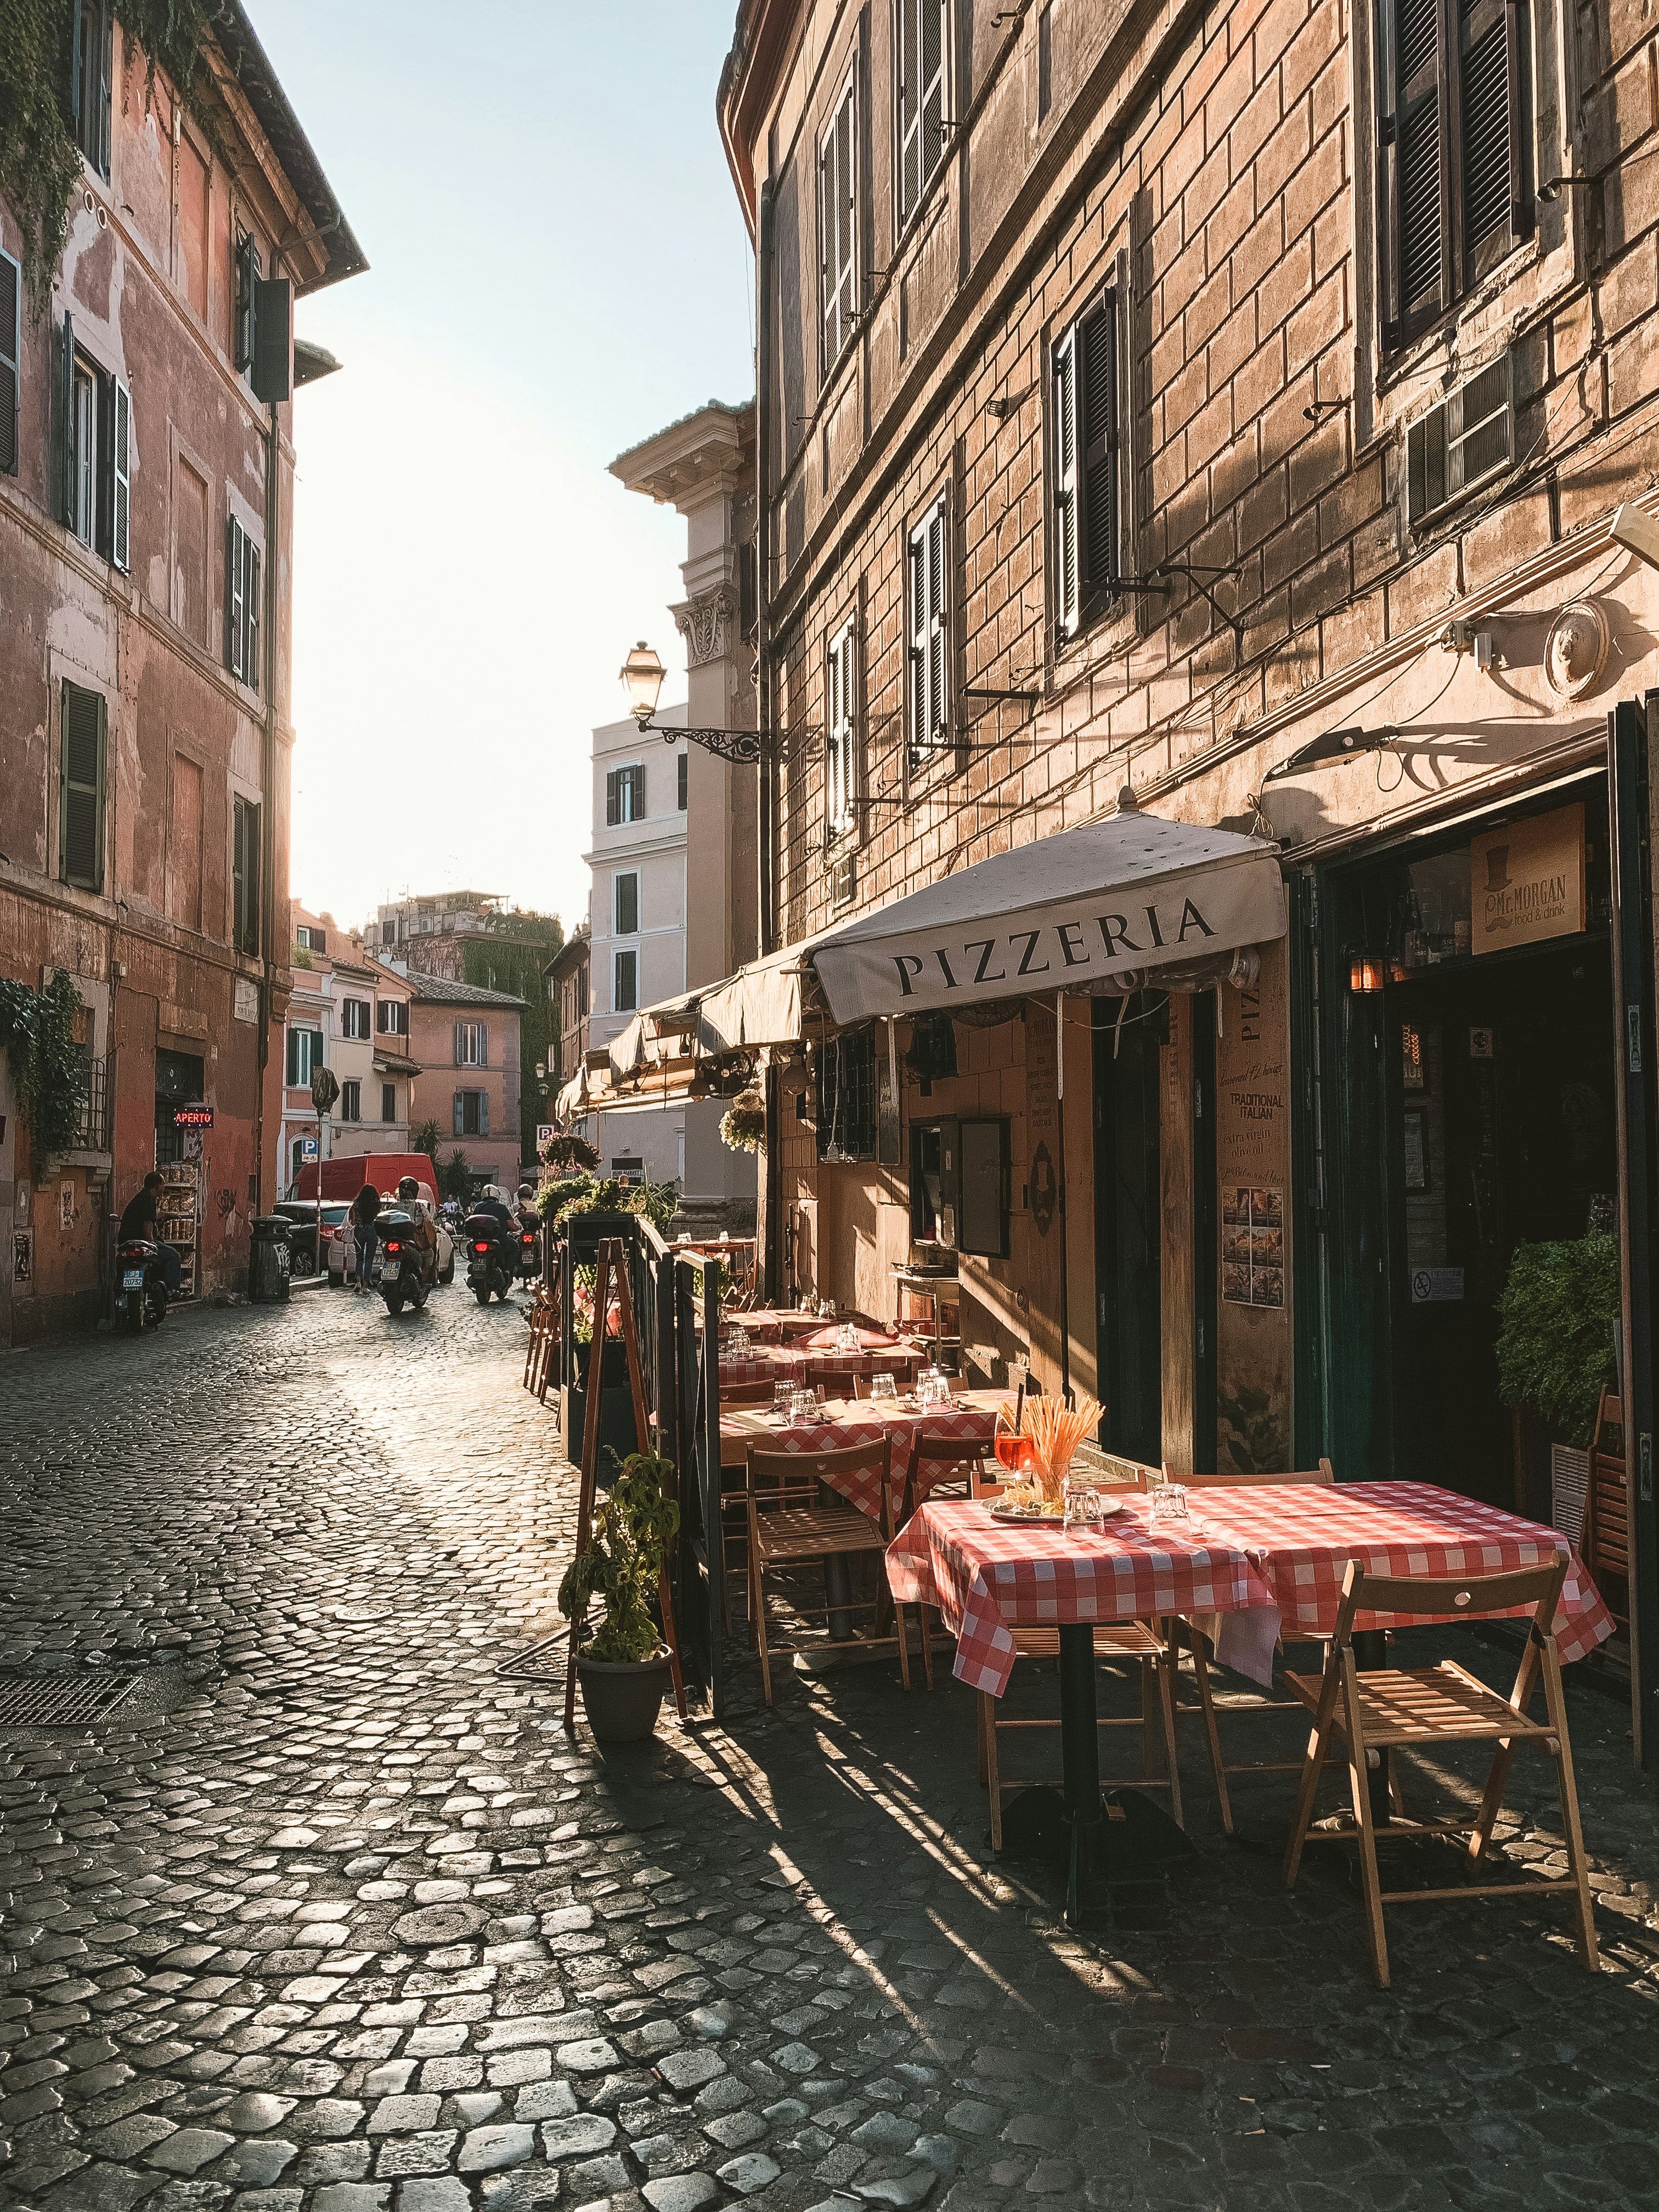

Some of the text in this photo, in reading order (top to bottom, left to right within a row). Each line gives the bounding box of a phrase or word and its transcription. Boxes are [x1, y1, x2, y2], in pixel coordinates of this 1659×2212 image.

[1514, 902, 1565, 926] food & drink
[888, 896, 1220, 997] PIZZERIA
[1230, 1093, 1284, 1108] TRADITIONAL
[176, 1113, 211, 1122] APERTO
[1240, 1105, 1273, 1120] ITALIAN
[541, 1128, 550, 1139] P
[305, 1141, 315, 1153] P
